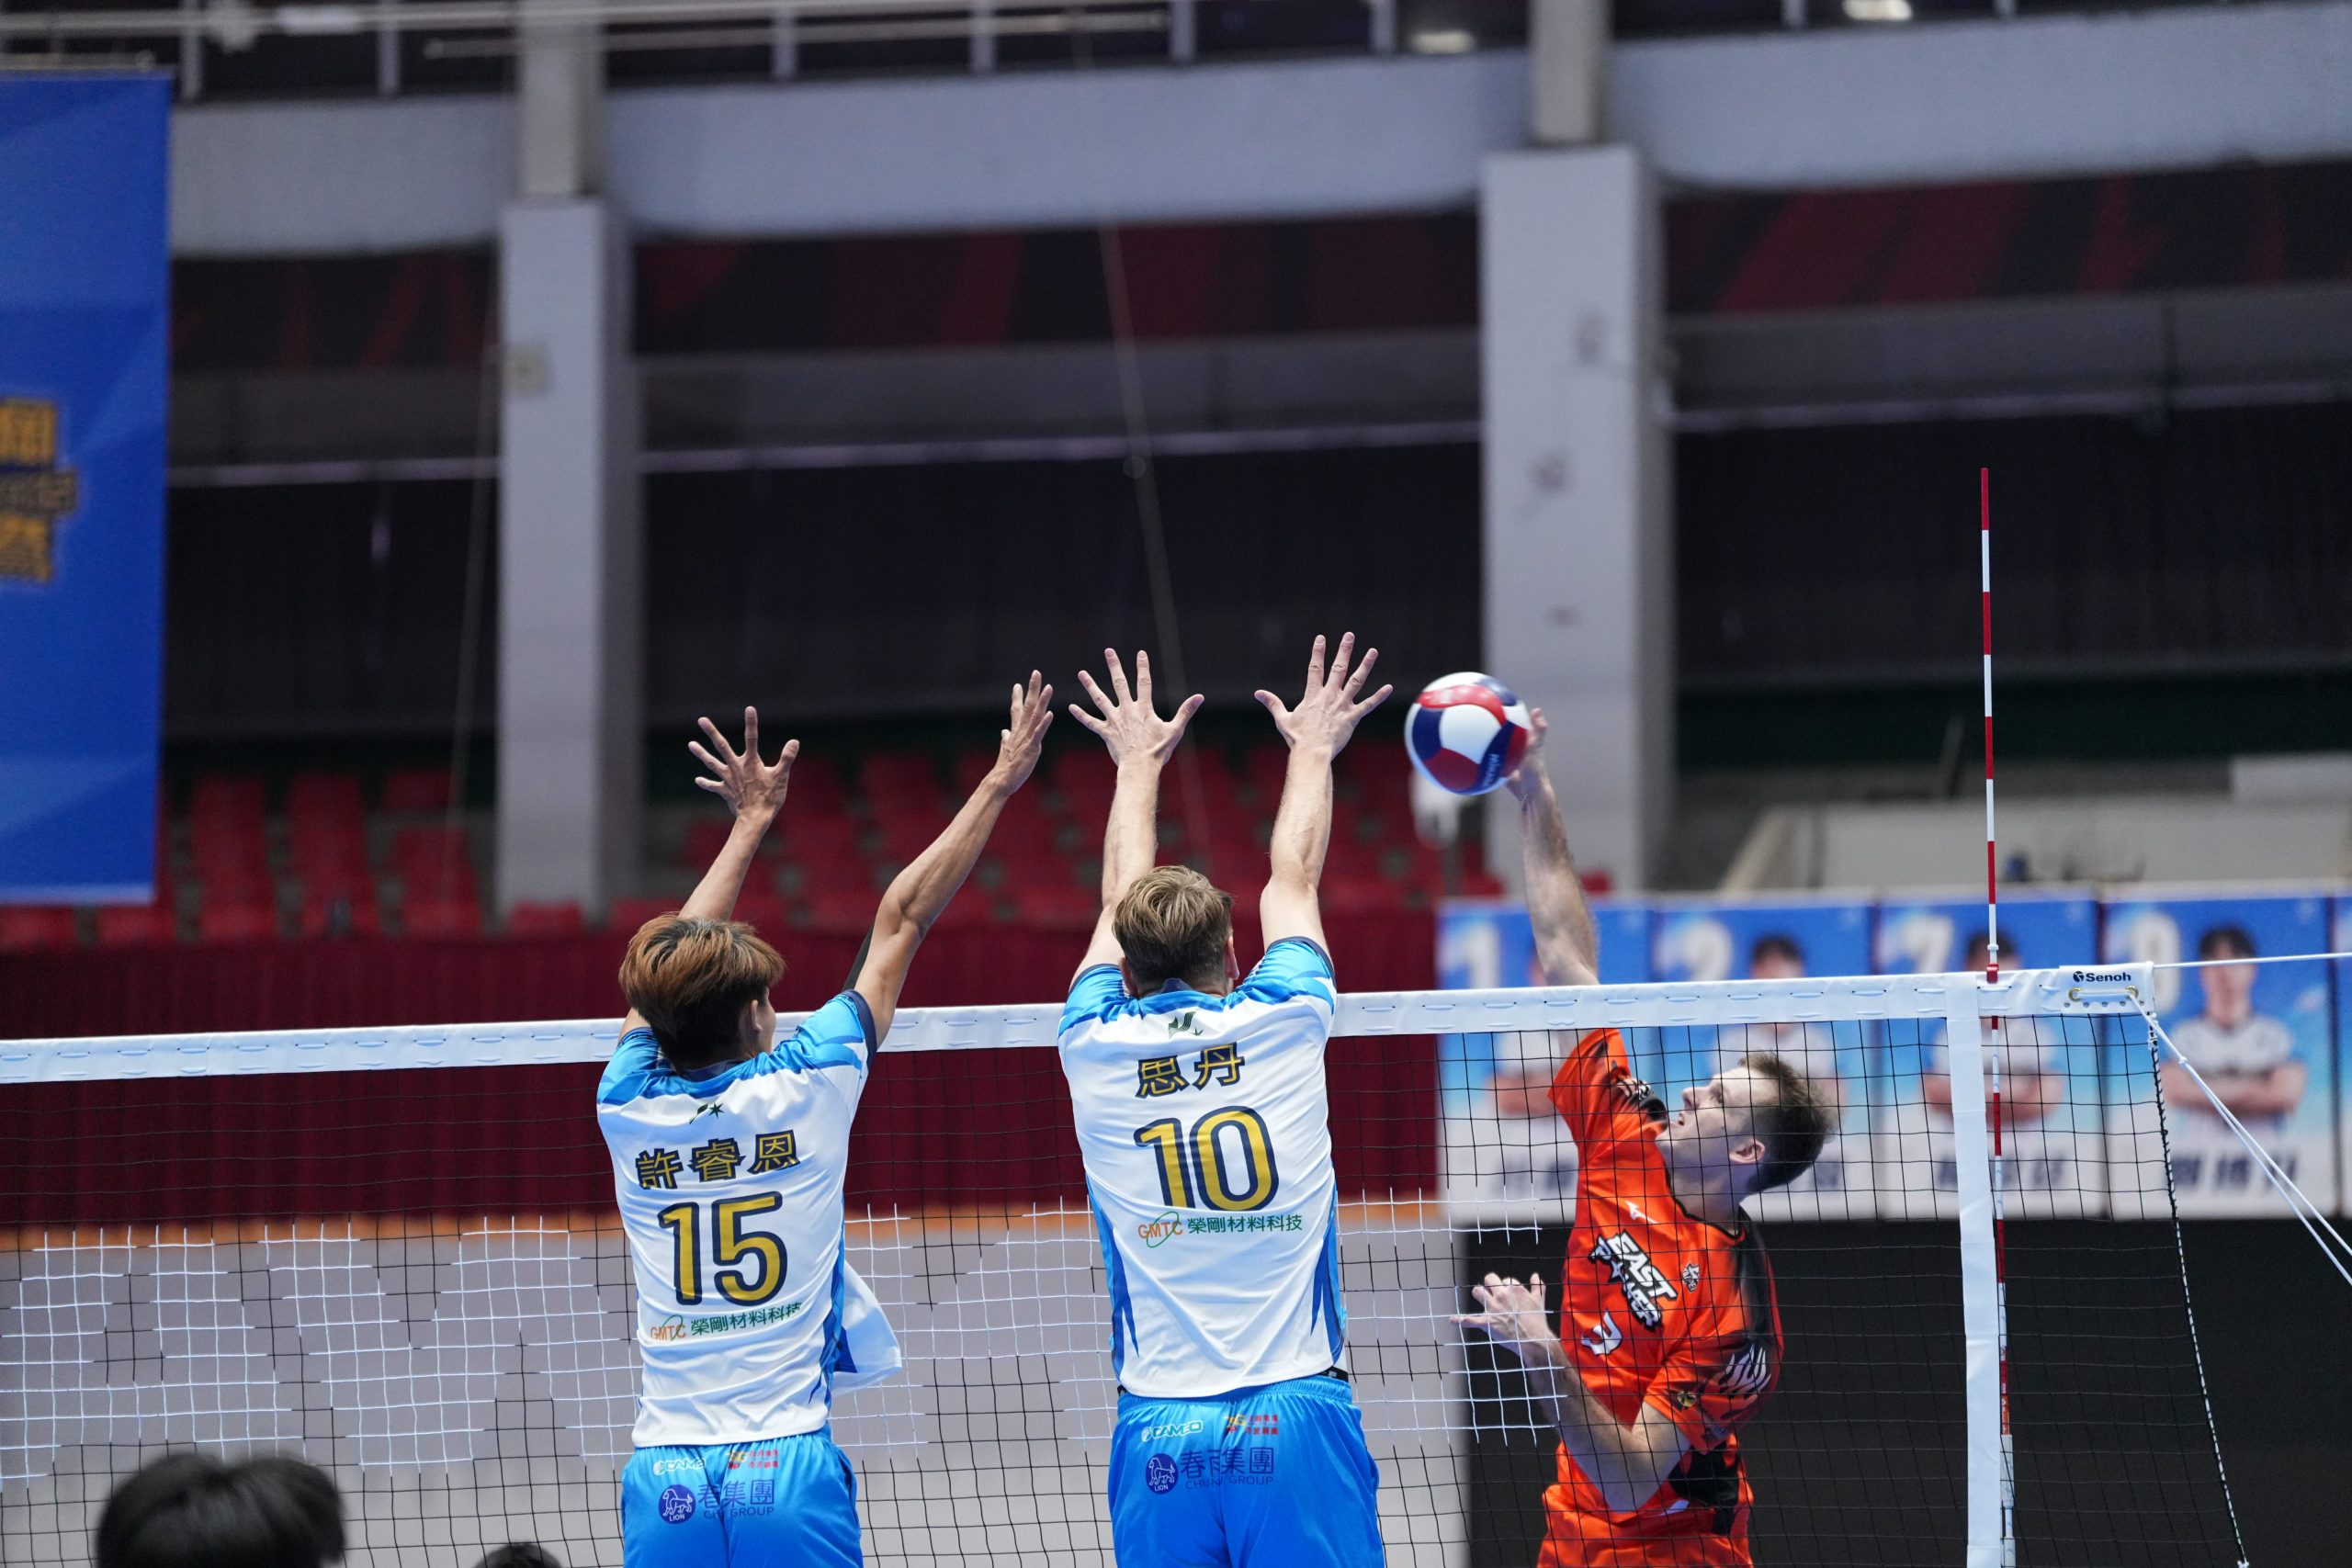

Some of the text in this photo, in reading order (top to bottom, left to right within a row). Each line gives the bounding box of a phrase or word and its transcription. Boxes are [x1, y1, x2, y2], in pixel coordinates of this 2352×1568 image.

[2086, 972, 2132, 982] Senoh
[1135, 1041, 1246, 1100] 思丹
[635, 1129, 801, 1190] 許睿恩
[1134, 1105, 1280, 1211] 10
[1137, 1213, 1303, 1240] GMTC 榮剛材料科技
[657, 1191, 788, 1306] 15
[1606, 1229, 1678, 1301] EAST
[650, 1323, 686, 1341] GMTC
[1152, 1420, 1204, 1439] CAMEO
[1154, 1483, 1169, 1492] LION
[1228, 1475, 1274, 1485] GROUP
[669, 1514, 685, 1522] LION
[730, 1506, 775, 1517] GROUP
